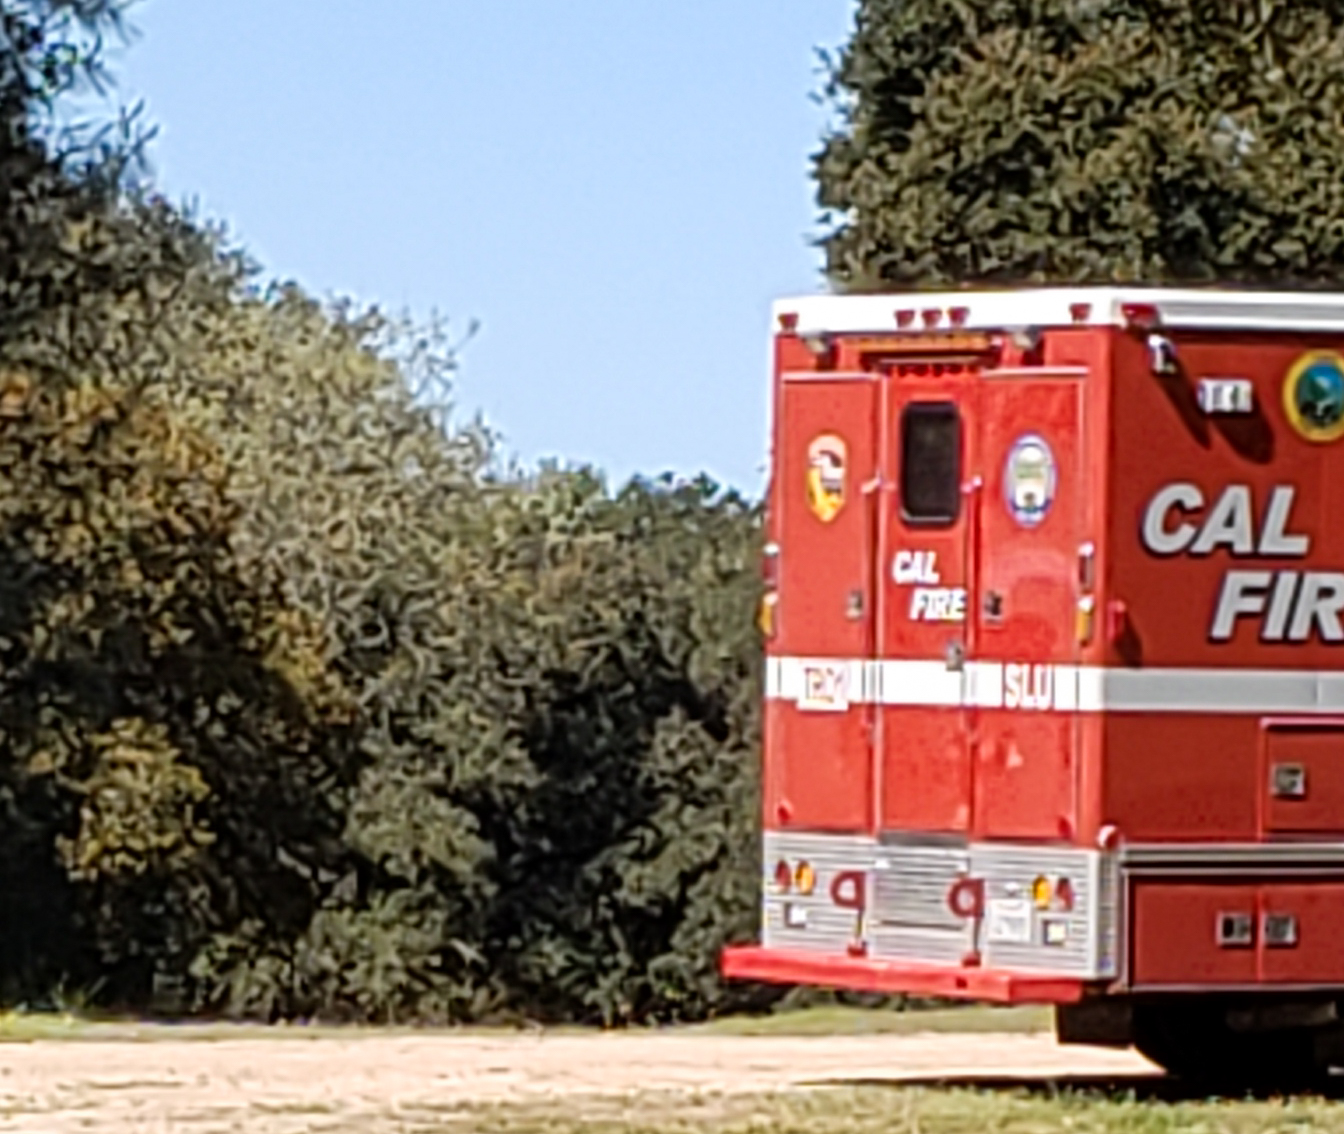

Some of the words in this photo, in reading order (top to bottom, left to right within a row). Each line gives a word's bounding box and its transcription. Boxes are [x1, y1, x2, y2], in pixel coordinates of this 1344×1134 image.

[1141, 482, 1311, 556] CAL
[892, 550, 940, 584] CAL
[909, 587, 967, 621] FIRE
[1004, 664, 1053, 708] SLU
